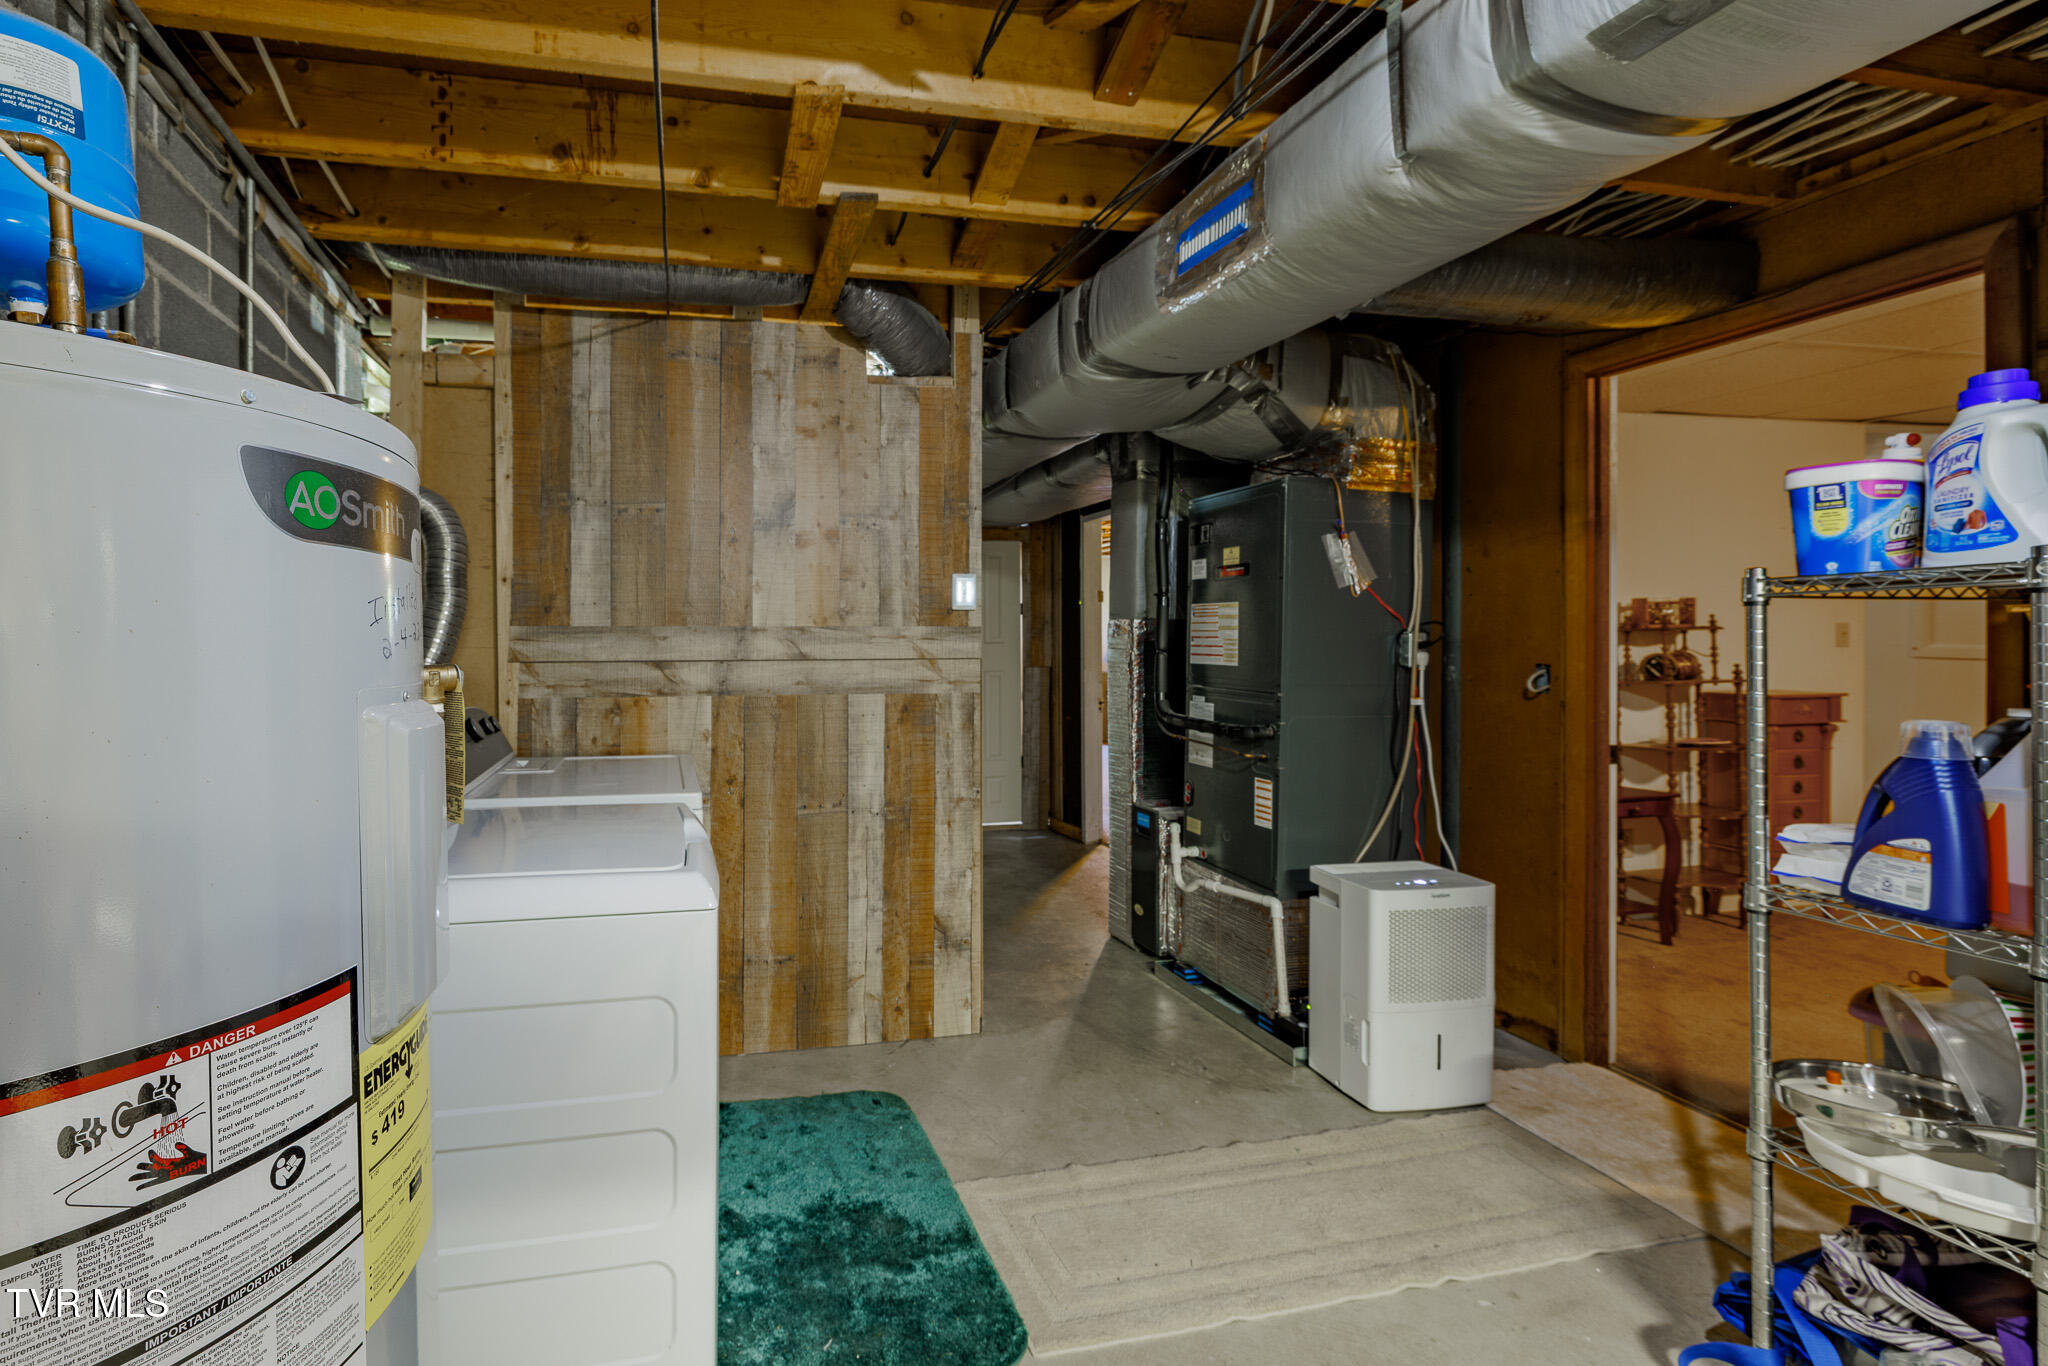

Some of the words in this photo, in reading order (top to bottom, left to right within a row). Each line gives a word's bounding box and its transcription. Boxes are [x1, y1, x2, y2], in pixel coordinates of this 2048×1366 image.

[1937, 443, 1973, 474] Lysol
[189, 1024, 256, 1058] DANGER
[216, 1050, 237, 1062] Water
[238, 1034, 278, 1054] temperature
[278, 1028, 292, 1038] over
[309, 1015, 319, 1023] can
[216, 1058, 238, 1070] cause
[239, 1049, 262, 1061] severe
[263, 1040, 281, 1052] burns
[282, 1029, 306, 1044] instantly
[216, 1067, 237, 1079] death
[238, 1060, 255, 1070] from
[255, 1050, 278, 1063] scalds.
[217, 1075, 249, 1091] Children,
[250, 1062, 278, 1078] disabled
[278, 1055, 290, 1066] and
[290, 1046, 310, 1060] elderly
[310, 1042, 319, 1051] are
[217, 1092, 225, 1101] at
[225, 1081, 252, 1097] highest
[253, 1075, 265, 1085] risk
[266, 1070, 274, 1079] of
[274, 1063, 291, 1076] being
[292, 1052, 315, 1067] scalded.
[217, 1104, 231, 1113] See
[232, 1087, 268, 1107] instruction
[269, 1075, 292, 1091] manual
[292, 1066, 311, 1080] before
[217, 1107, 242, 1122] setting
[243, 1088, 282, 1111] temperature
[282, 1084, 289, 1092] at
[290, 1076, 305, 1088] water
[153, 1116, 189, 1140] HOT
[217, 1123, 234, 1136] Feel
[234, 1114, 254, 1127] water
[254, 1103, 275, 1118] before
[276, 1092, 299, 1108] bathing
[218, 1132, 261, 1156] Temperature
[262, 1119, 286, 1135] limiting
[286, 1109, 305, 1123] valves
[305, 1103, 314, 1112] are
[382, 1099, 405, 1134] 419
[218, 1123, 257, 1143] showering.
[218, 1144, 252, 1165] available,
[252, 1139, 265, 1148] see
[265, 1125, 290, 1141] manual.
[169, 1157, 206, 1180] BURN
[76, 1240, 97, 1252] TIME
[99, 1234, 111, 1243] TO
[113, 1217, 152, 1238] PRODUCE
[155, 1201, 187, 1219] SERIOUS
[76, 1243, 106, 1259] BURNS
[108, 1236, 120, 1246] ON
[121, 1226, 147, 1240] ADULT
[149, 1217, 167, 1229] SKIN
[13, 1315, 29, 1325] The
[97, 1275, 126, 1290] serious
[128, 1265, 149, 1278] burns
[150, 1260, 160, 1268] on
[161, 1254, 173, 1262] the
[174, 1245, 189, 1257] skin
[190, 1240, 198, 1249] of
[198, 1230, 222, 1245] infants,
[223, 1215, 249, 1231] children,
[250, 1207, 260, 1217] and
[31, 1253, 63, 1268] WATER
[76, 1251, 101, 1265] About
[103, 1245, 114, 1255] 1/2
[116, 1233, 144, 1247] second
[76, 1257, 101, 1271] About
[110, 1249, 121, 1259] 1/2
[122, 1236, 154, 1253] seconds
[77, 1266, 97, 1278] Less
[98, 1258, 115, 1270] than
[123, 1242, 155, 1259] seconds
[0, 1260, 62, 1287] EMPERATURE
[16, 1331, 32, 1341] you
[33, 1324, 46, 1334] set
[48, 1319, 60, 1328] the
[164, 1267, 177, 1276] low
[202, 1244, 222, 1257] higher
[223, 1224, 258, 1246] temperatures
[77, 1271, 101, 1285] About
[103, 1265, 113, 1274] 30
[114, 1252, 146, 1269] seconds
[77, 1278, 98, 1291] More
[99, 1271, 117, 1283] than
[124, 1254, 155, 1271] minutes
[120, 1272, 149, 1289] Valves
[0, 1336, 57, 1363] quirements
[60, 1324, 86, 1339] when
[183, 1268, 201, 1281] heat
[202, 1254, 228, 1272] source
[145, 1302, 219, 1351] IMPORTANT
[227, 1255, 294, 1306] IMPORTANTE
[18, 1339, 68, 1364] supplemental
[69, 1332, 86, 1342] heat
[87, 1321, 111, 1334] source
[37, 1326, 62, 1340] Mixing
[63, 1315, 87, 1328] Valves
[37, 1350, 62, 1363] source
[63, 1330, 106, 1353] temperature
[108, 1323, 119, 1332] not
[77, 1347, 103, 1361] source
[105, 1331, 134, 1350] (located
[143, 1321, 154, 1330] the
[156, 1311, 175, 1324] water
[199, 1291, 211, 1302] and
[63, 1346, 87, 1361] heater
[88, 1340, 101, 1349] has
[103, 1331, 120, 1342] been
[99, 1345, 120, 1360] adjust
[121, 1337, 136, 1349] both
[276, 1341, 300, 1364] NOTICE
